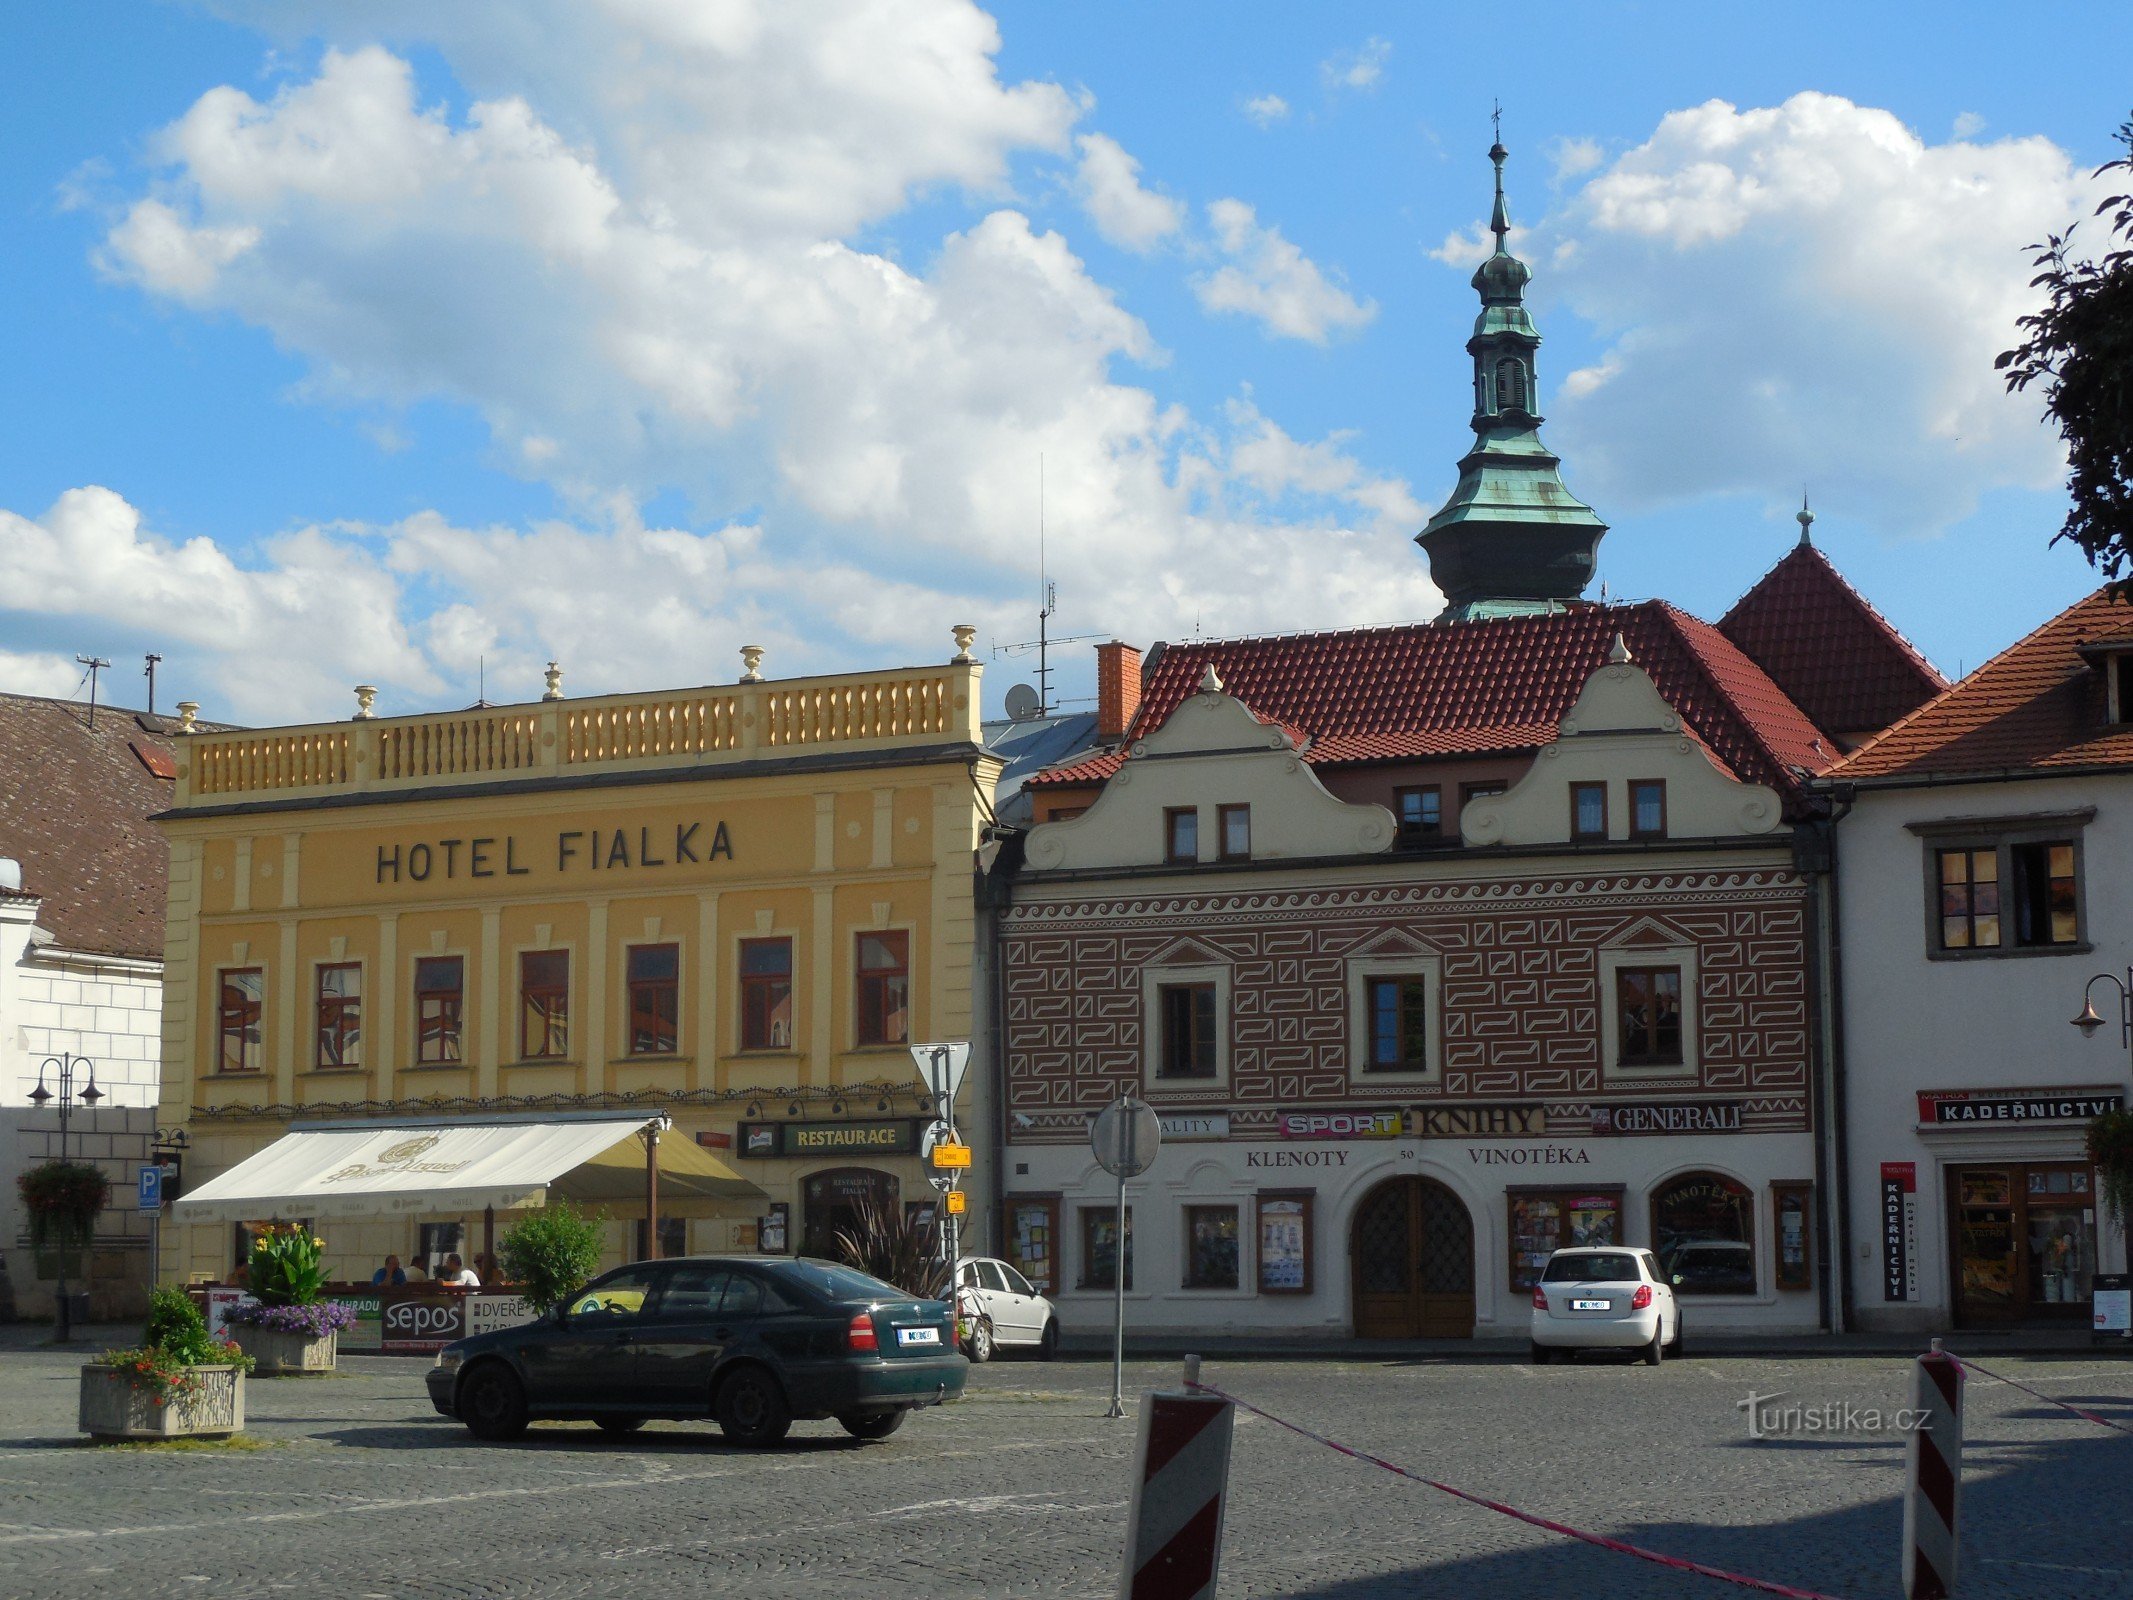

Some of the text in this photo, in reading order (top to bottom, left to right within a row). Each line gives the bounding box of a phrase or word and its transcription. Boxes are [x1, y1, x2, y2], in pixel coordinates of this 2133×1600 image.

[376, 820, 734, 884] HOTEL FIALKA
[1421, 1107, 1537, 1134] KNIHY
[1614, 1105, 1743, 1131] GENERALI
[1944, 1098, 2116, 1121] KADEŘNICTVÍ
[1160, 1119, 1213, 1132] ALITY
[1286, 1113, 1396, 1134] SPORT
[797, 1128, 896, 1146] RESTAURACE
[1247, 1150, 1349, 1168] KLENOTY
[1400, 1150, 1414, 1160] 50
[1467, 1144, 1591, 1165] VINOTÉKA
[143, 1171, 156, 1195] P
[1577, 1201, 1614, 1209] SPORT
[1665, 1184, 1741, 1208] VINOTÉKA
[1887, 1184, 1901, 1296] KADEŘNICTVÍ
[386, 1301, 460, 1336] sepos
